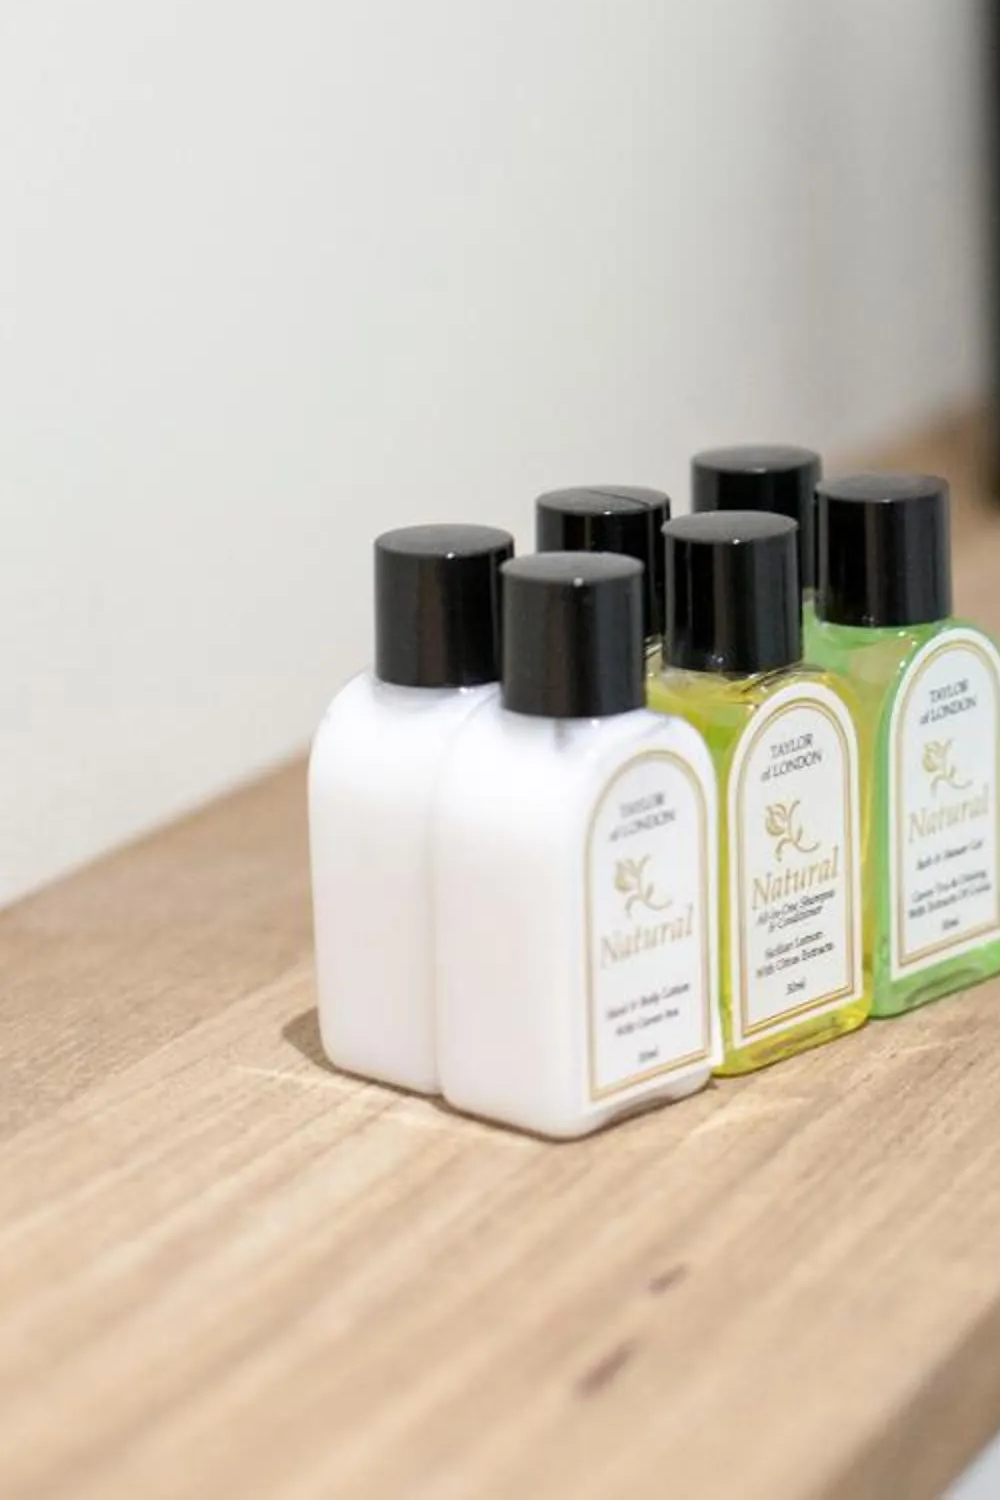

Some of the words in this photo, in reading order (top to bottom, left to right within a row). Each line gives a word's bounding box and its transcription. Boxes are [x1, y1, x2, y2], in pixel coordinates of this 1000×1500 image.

[930, 679, 967, 703] TAYLOR
[931, 695, 976, 721] LONDON
[770, 733, 813, 759] TAYLOR
[773, 749, 822, 776] LONDON
[622, 809, 676, 837] LONDON
[908, 783, 989, 844] Natural
[752, 845, 838, 911] Natural
[600, 902, 693, 969] Natural
